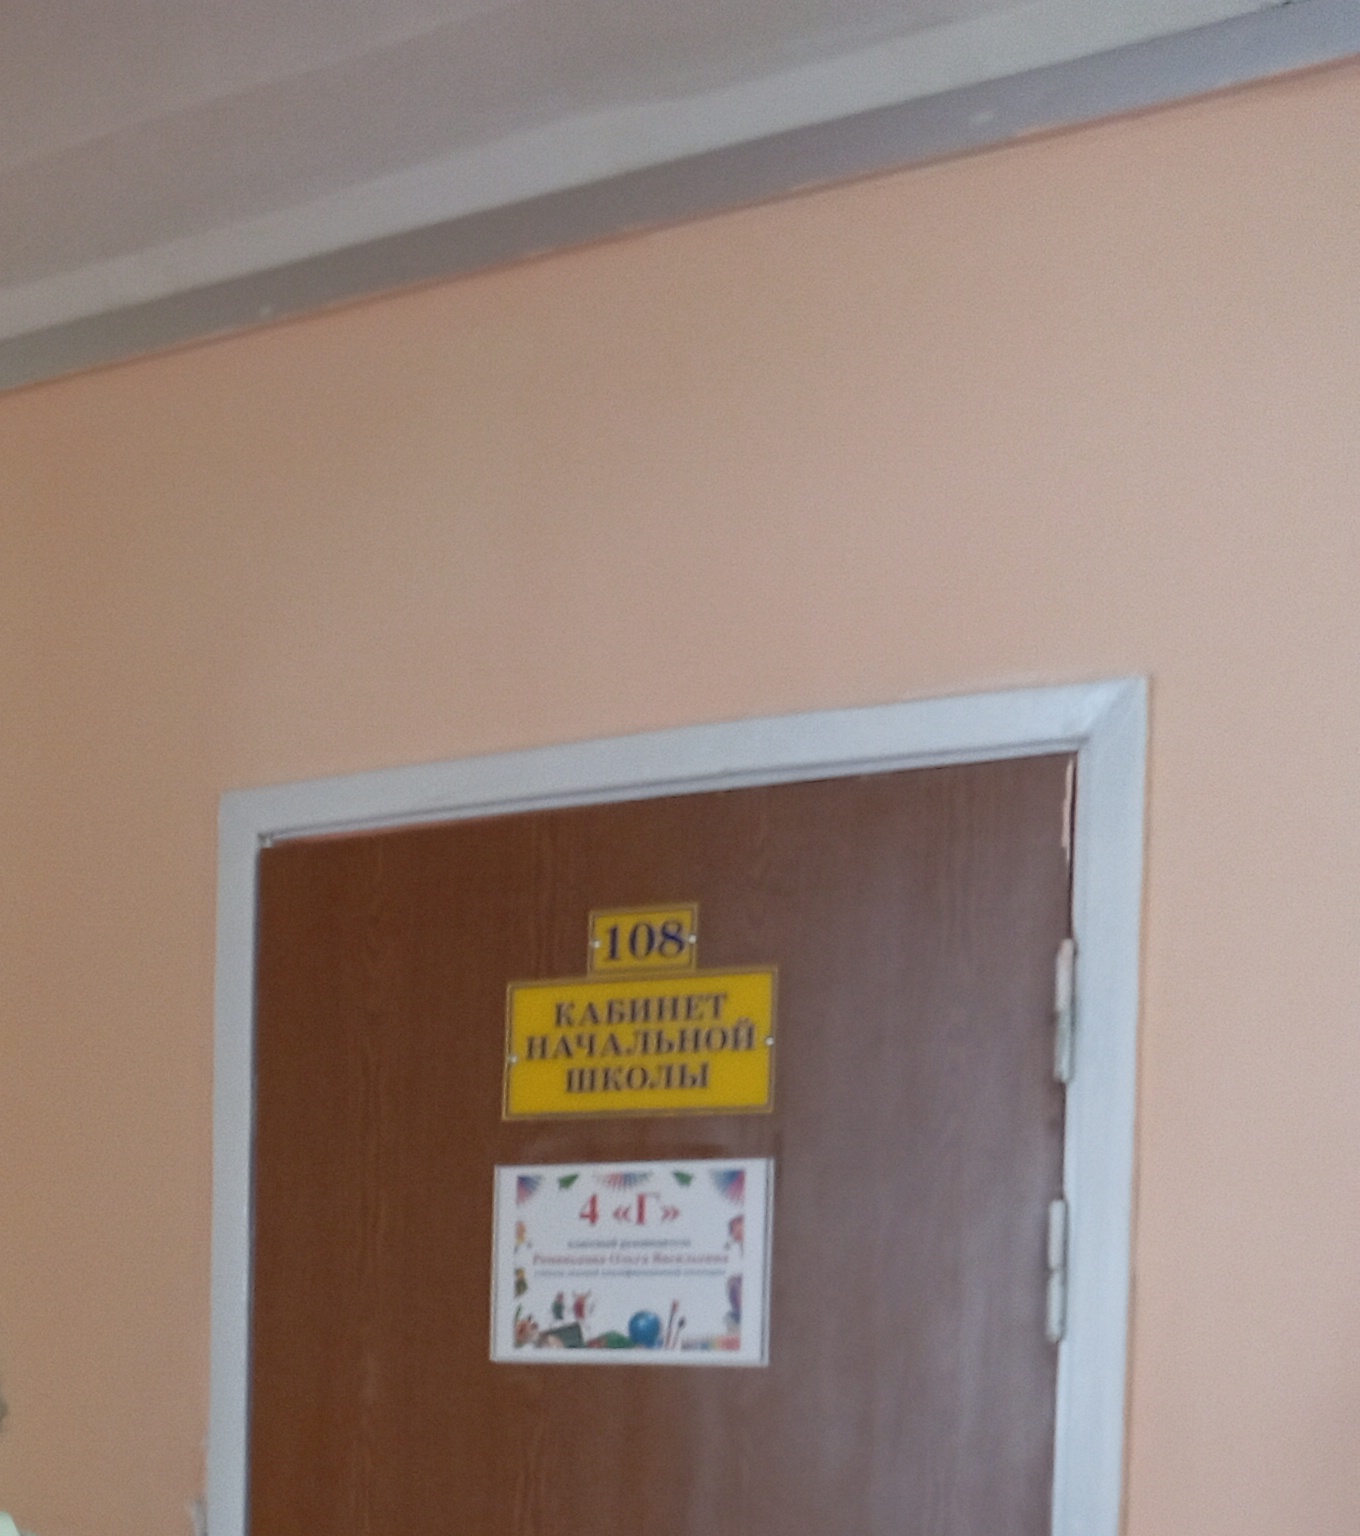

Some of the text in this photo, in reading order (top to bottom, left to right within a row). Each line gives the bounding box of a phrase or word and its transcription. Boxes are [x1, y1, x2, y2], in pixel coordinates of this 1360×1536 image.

[608, 919, 685, 960] 108
[555, 992, 728, 1028] КАБИНЕТ
[526, 1017, 755, 1061] НАЧАЛЬНОЙ
[566, 1062, 710, 1094] ШКОЛЫ
[579, 1193, 599, 1225] 4
